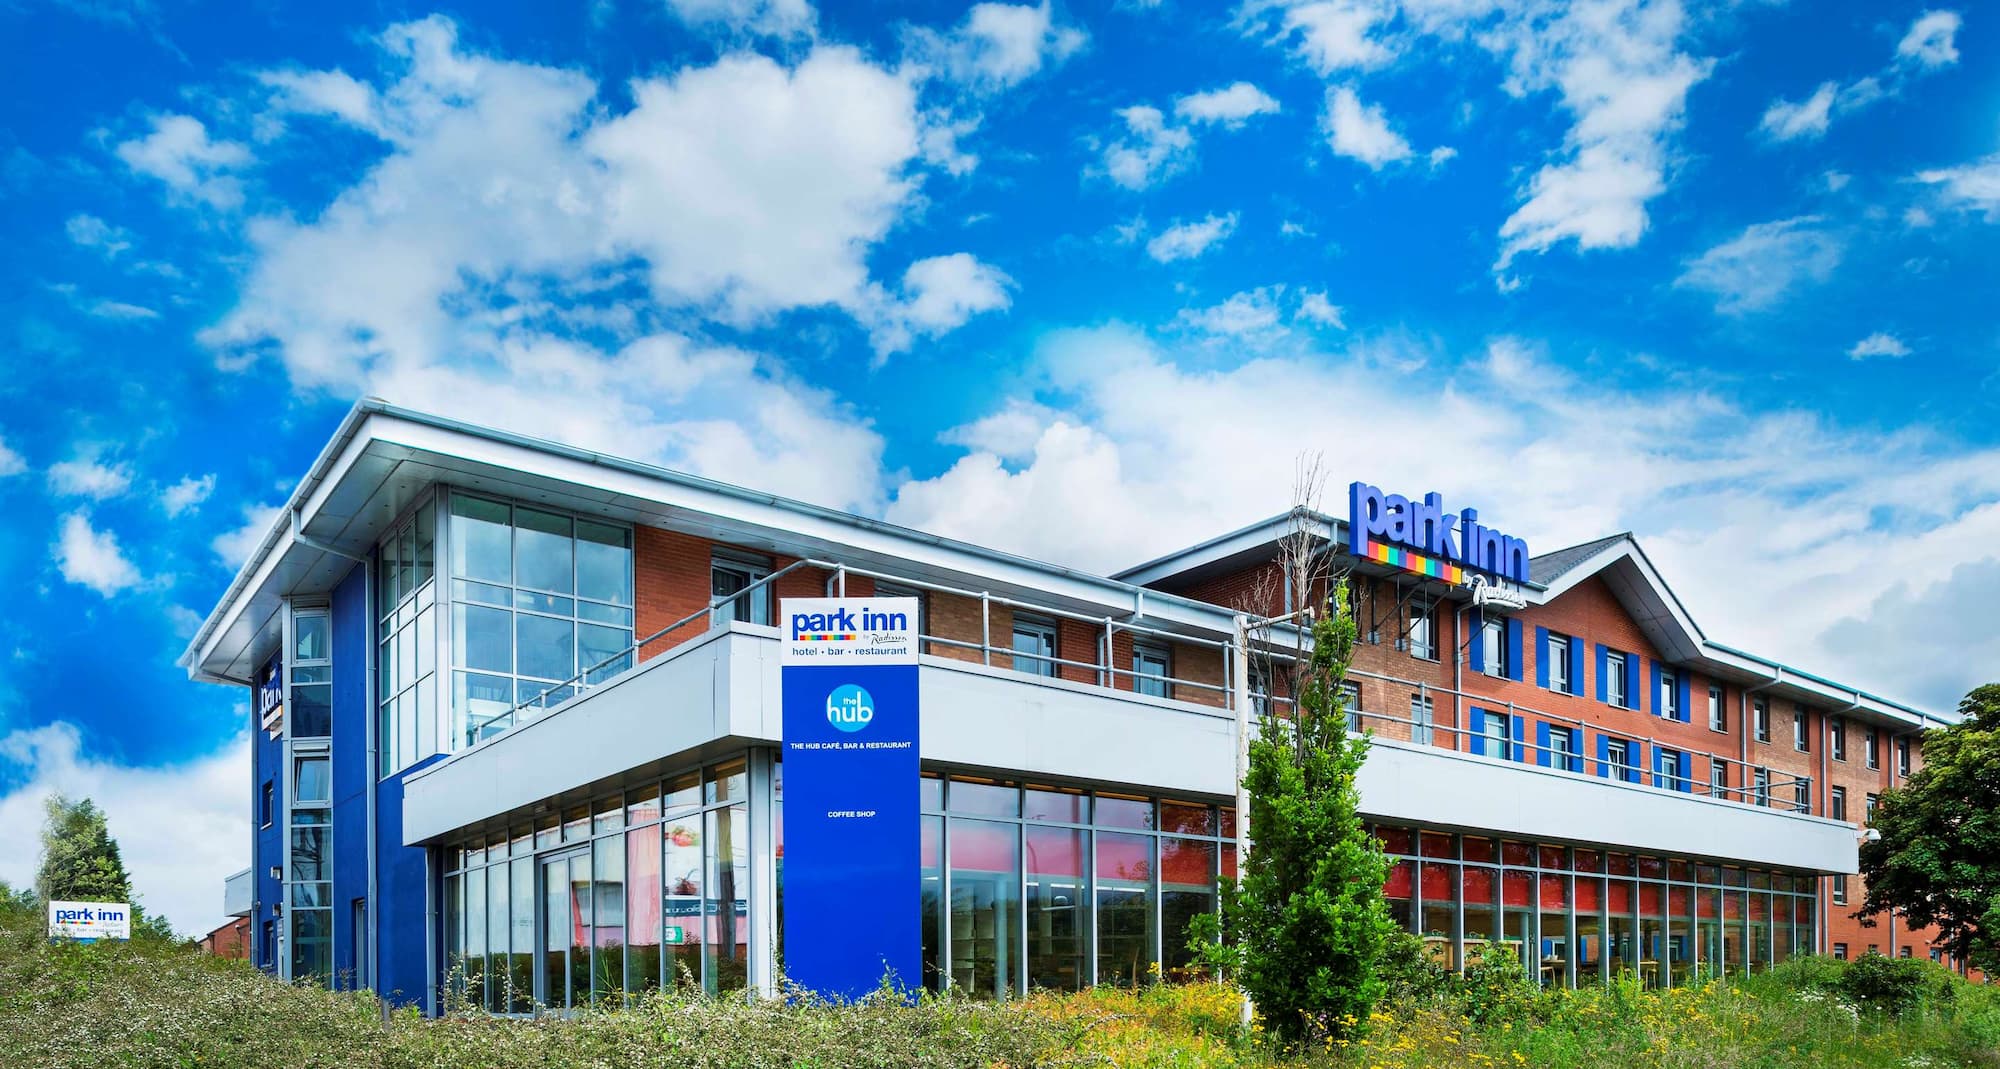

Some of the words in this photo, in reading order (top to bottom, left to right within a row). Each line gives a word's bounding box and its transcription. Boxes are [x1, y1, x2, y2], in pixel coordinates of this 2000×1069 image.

[1350, 481, 1460, 560] park
[1461, 507, 1530, 583] inn
[792, 607, 857, 641] park
[863, 607, 907, 631] inn
[792, 647, 818, 656] hotel
[828, 647, 845, 656] bar
[855, 647, 907, 655] restaurant
[827, 691, 873, 722] hub
[843, 697, 857, 705] the
[821, 741, 842, 750] CAFÉ,
[56, 908, 94, 924] park
[98, 908, 123, 921] inn
